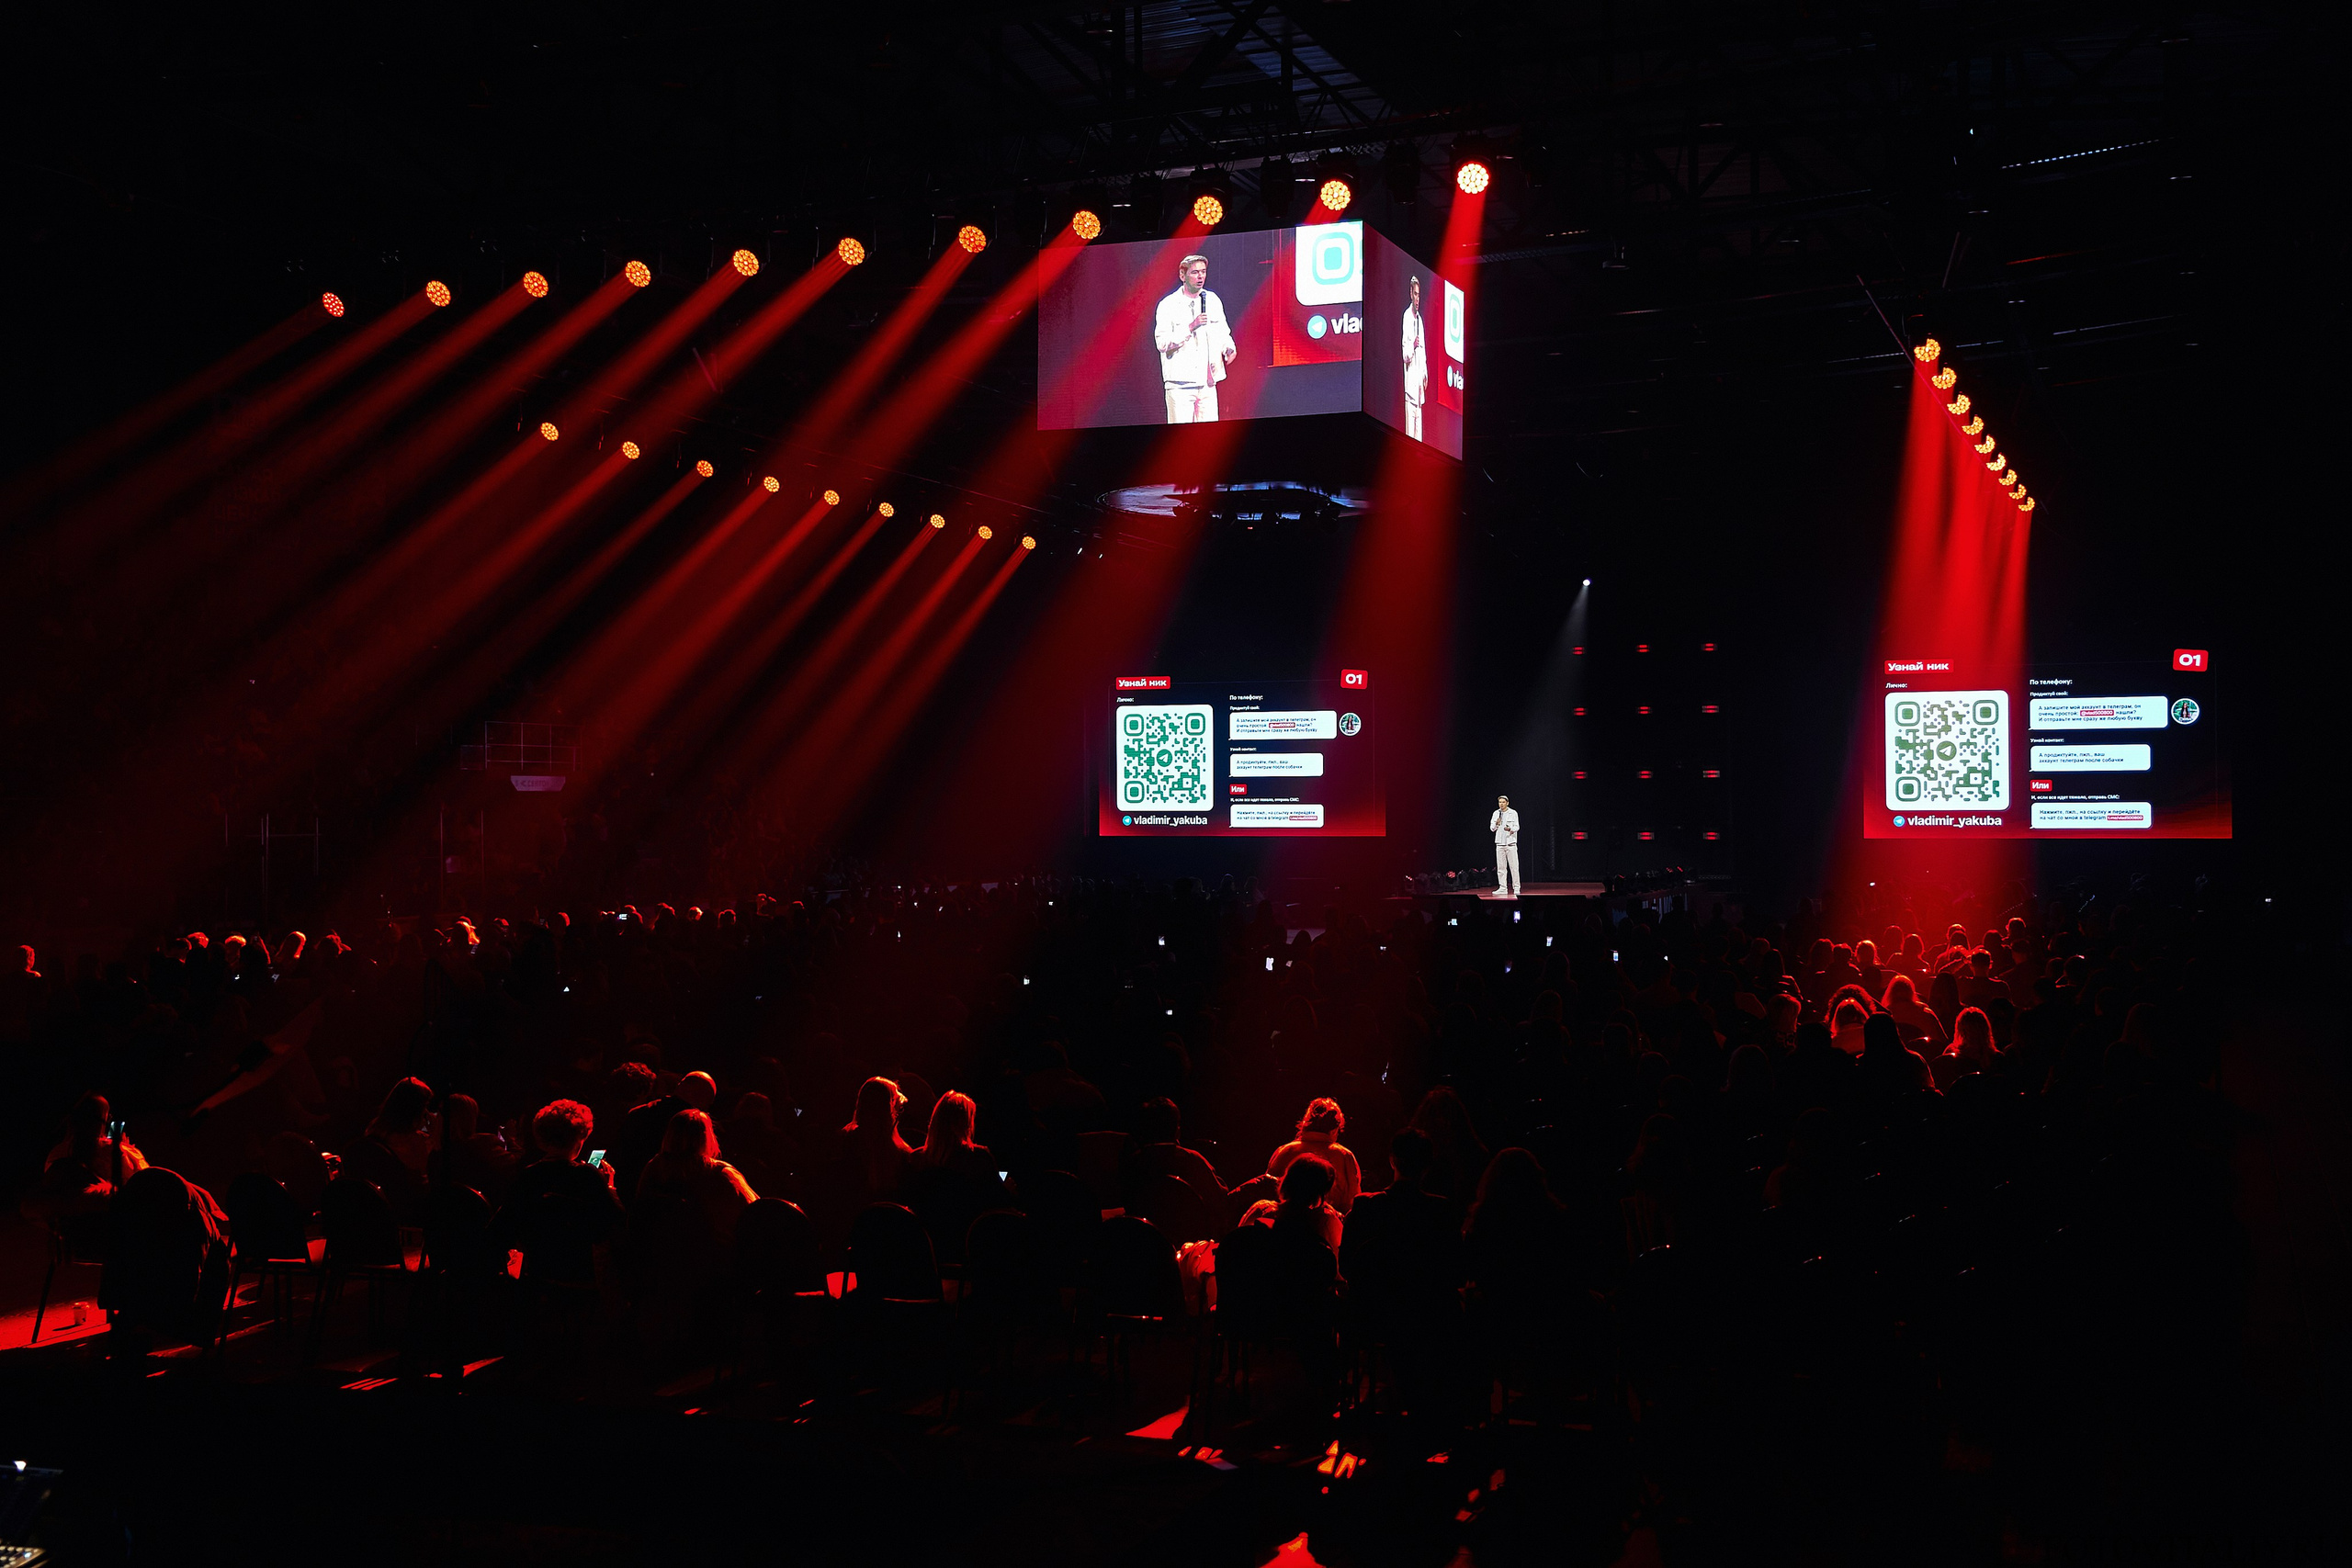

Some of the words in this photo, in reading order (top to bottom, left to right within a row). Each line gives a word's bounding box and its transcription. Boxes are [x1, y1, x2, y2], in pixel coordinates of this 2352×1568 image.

[2179, 654, 2201, 666] 01
[1888, 662, 1923, 671] Узнай
[1119, 678, 1147, 687] Узнай
[1134, 815, 1208, 827] vladimir_yakuba
[1907, 815, 2002, 828] vladimir_yakuba
